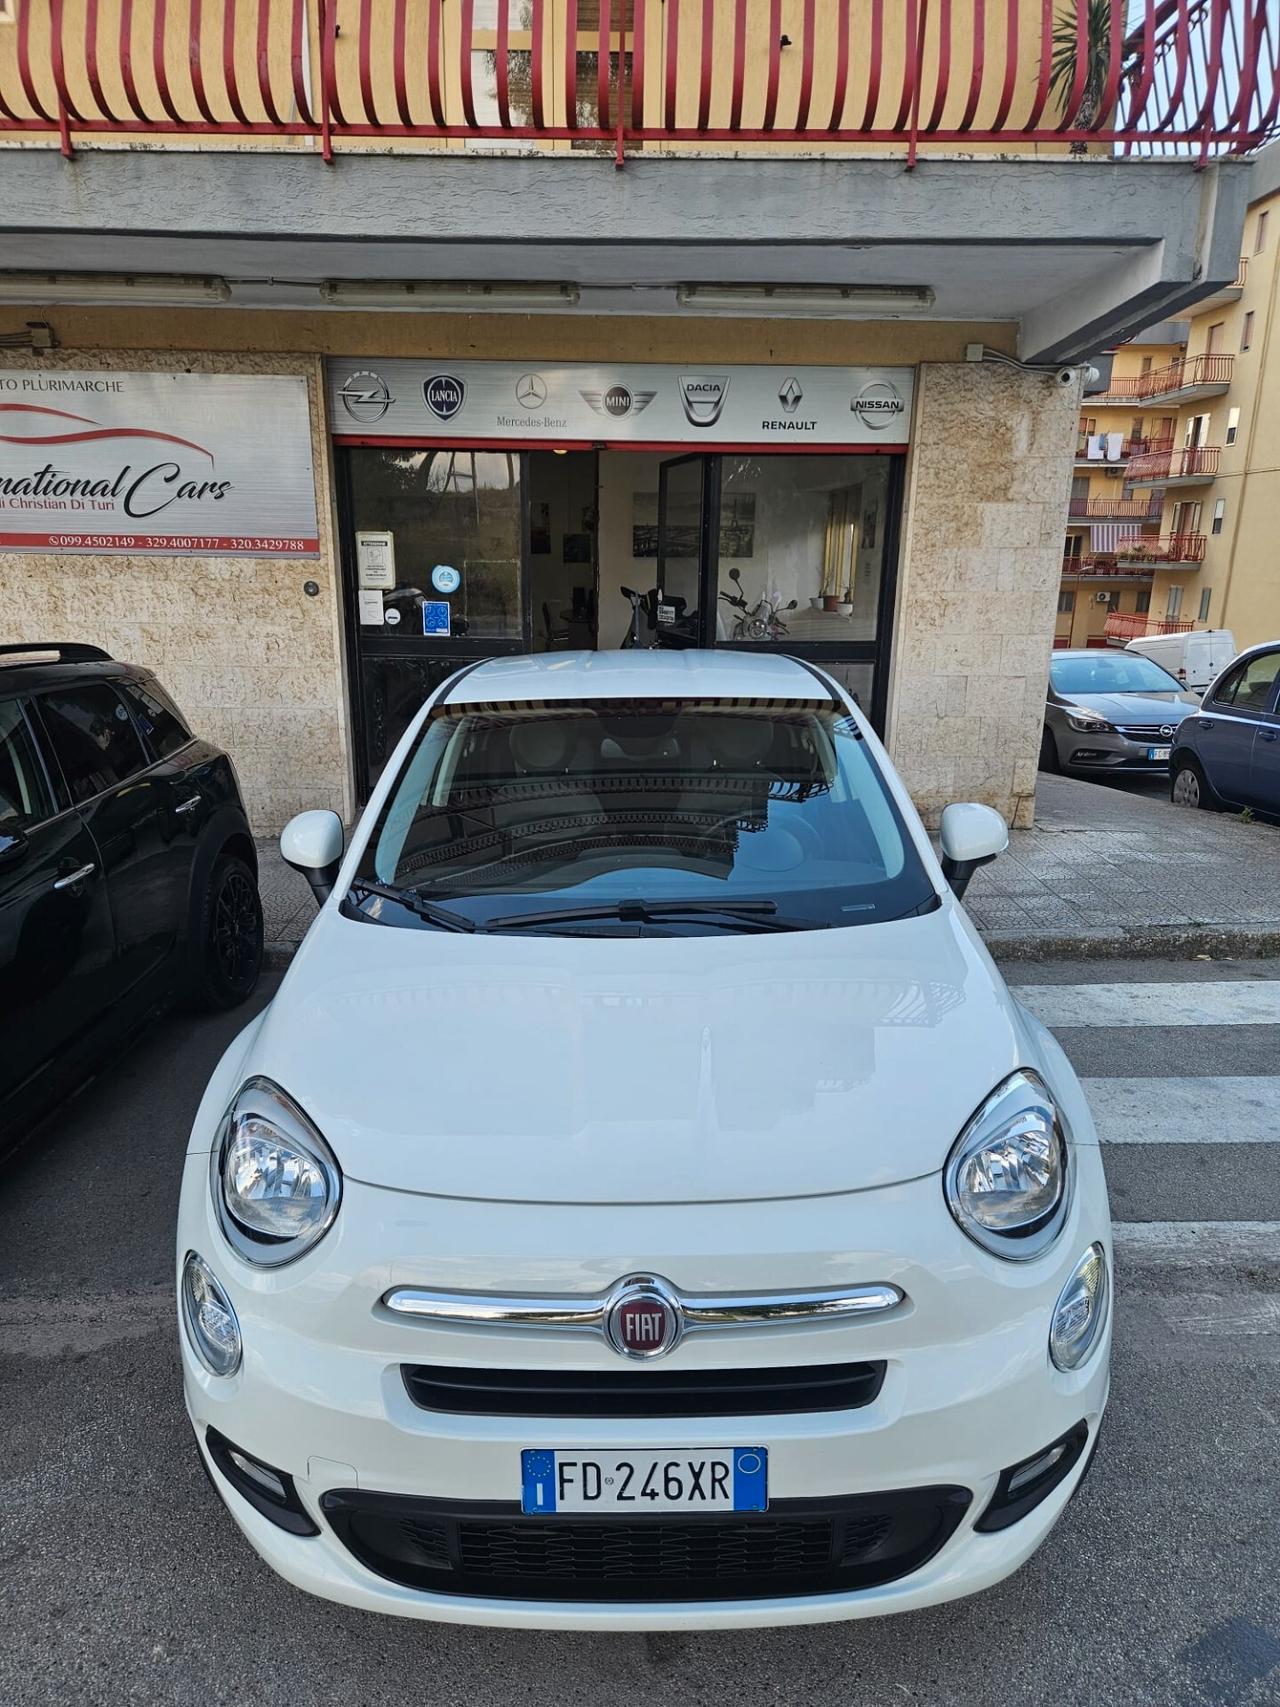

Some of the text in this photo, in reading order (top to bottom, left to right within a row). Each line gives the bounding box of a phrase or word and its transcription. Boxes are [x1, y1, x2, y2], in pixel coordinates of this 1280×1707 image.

[22, 379, 125, 392] PLURIMARCHE
[686, 383, 721, 393] DACIA
[431, 389, 458, 402] LANCIA
[606, 396, 631, 406] MINI
[855, 400, 900, 409] NISSAN
[497, 416, 568, 428] Mercedes-Benz
[762, 420, 817, 430] RENAULT
[124, 462, 234, 518] Cars
[9, 497, 67, 510] Christian
[71, 499, 85, 510] Di
[91, 499, 115, 511] Turi
[60, 536, 135, 547] 099.4502149
[146, 537, 220, 549] 329.4007177
[230, 539, 304, 550] 320.3429788
[626, 1312, 662, 1341] FIAT
